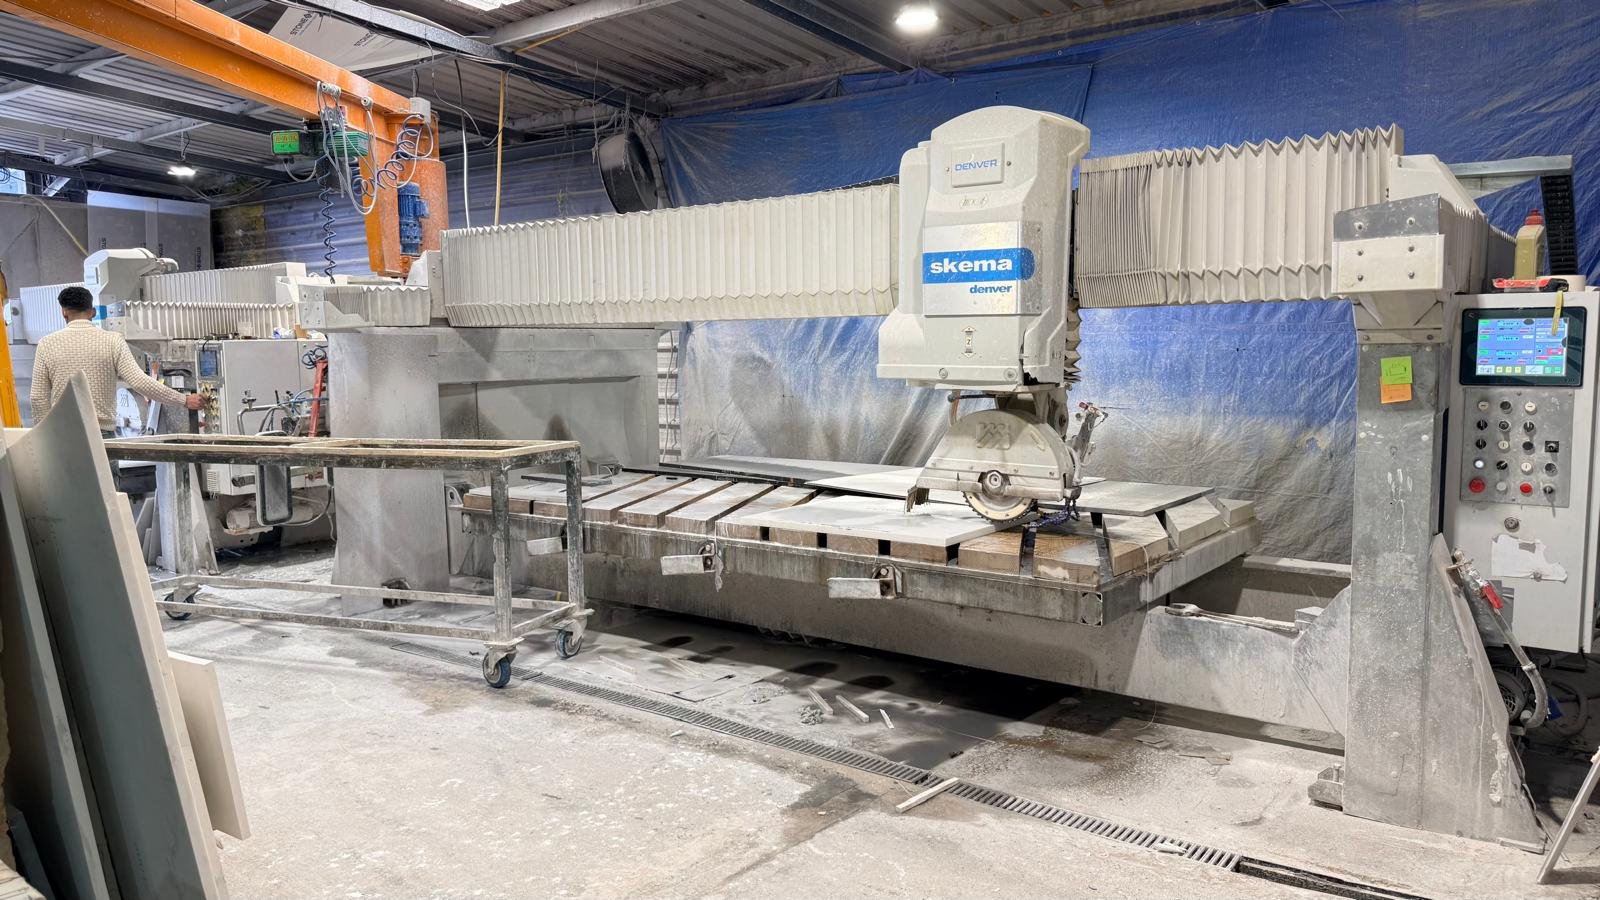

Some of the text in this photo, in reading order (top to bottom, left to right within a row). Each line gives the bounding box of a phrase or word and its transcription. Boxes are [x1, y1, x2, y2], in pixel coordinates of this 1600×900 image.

[290, 18, 308, 35] STONE
[955, 159, 998, 171] DENVER
[930, 258, 1012, 274] skema
[969, 285, 1012, 294] denver
